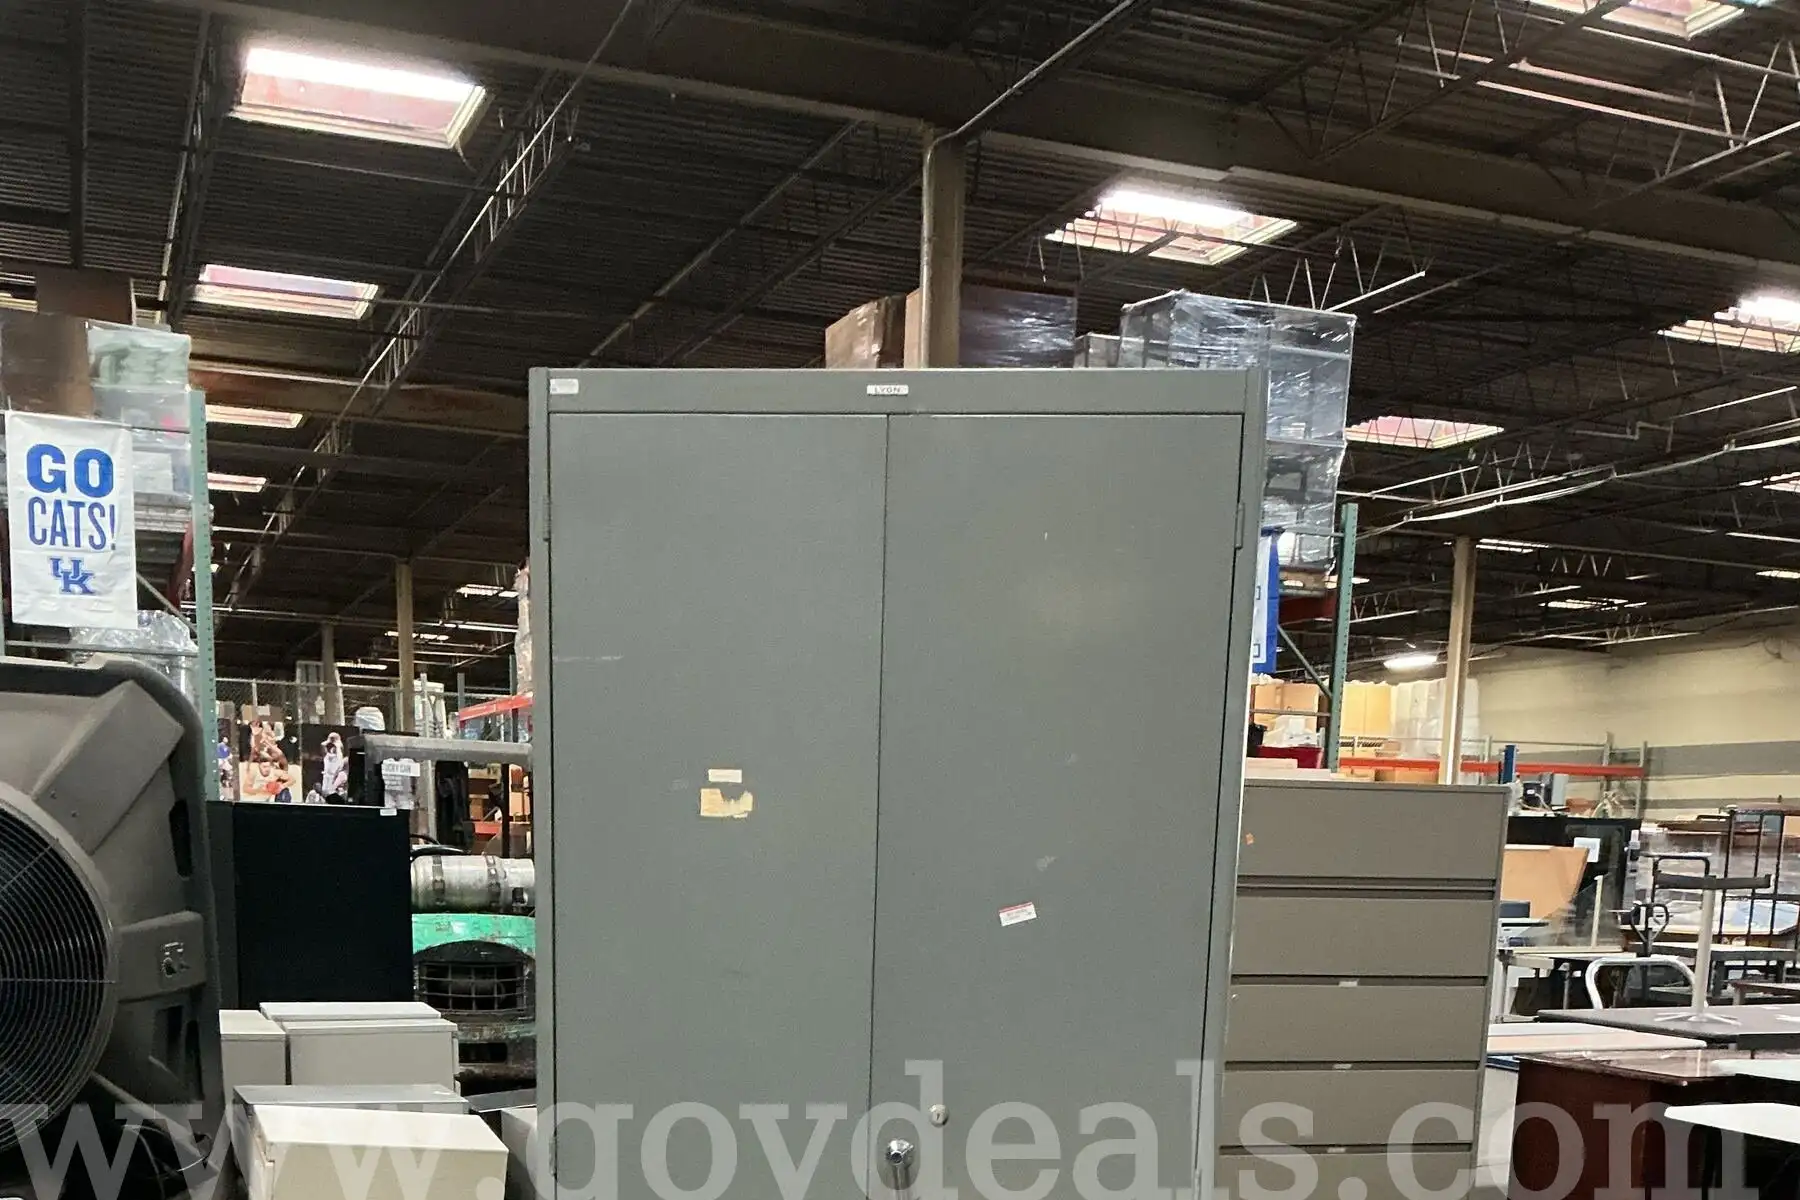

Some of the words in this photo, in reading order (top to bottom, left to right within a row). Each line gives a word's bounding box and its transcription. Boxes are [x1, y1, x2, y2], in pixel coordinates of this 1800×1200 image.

[26, 443, 114, 498] GO
[28, 496, 116, 550] CATS!
[49, 556, 96, 595] UK
